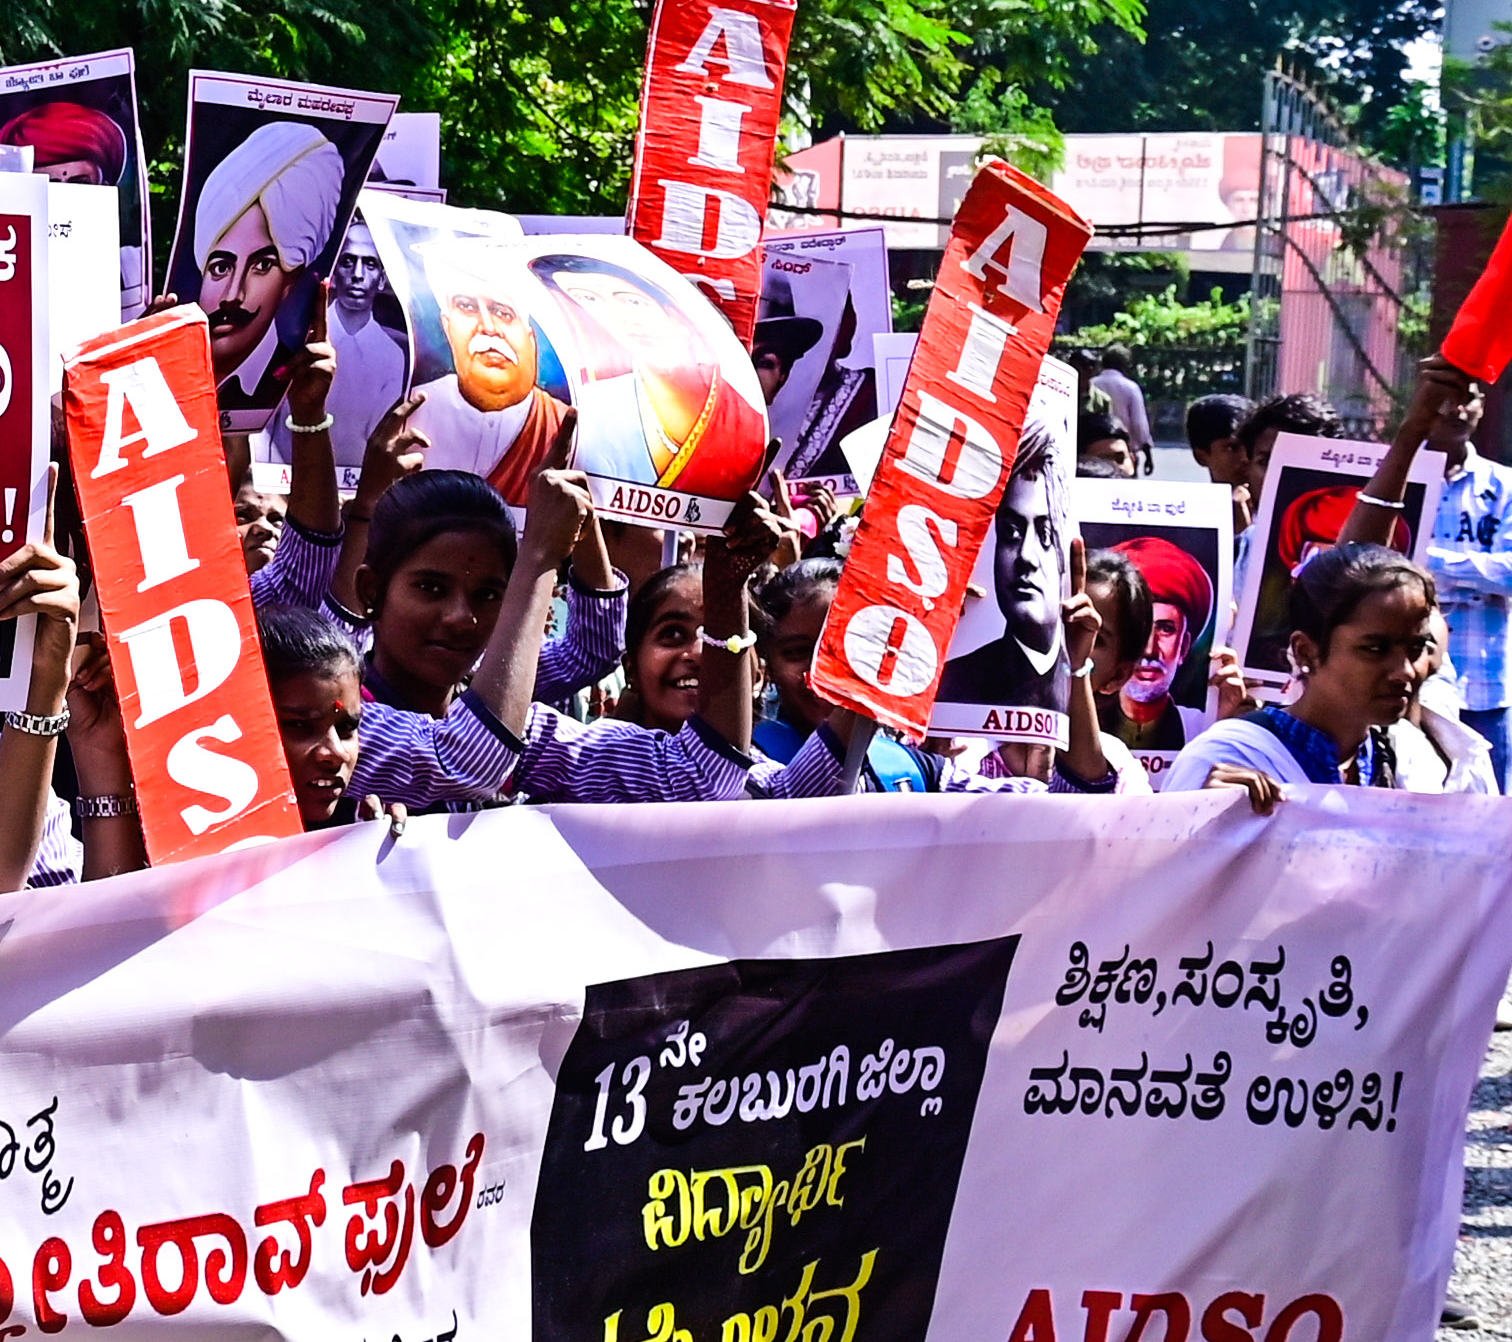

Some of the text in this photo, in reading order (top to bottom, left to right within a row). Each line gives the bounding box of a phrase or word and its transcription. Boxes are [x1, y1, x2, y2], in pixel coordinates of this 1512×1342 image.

[610, 487, 681, 518] AIDSO
[843, 201, 1049, 699] AIDSO
[89, 356, 281, 859] AIDS
[982, 707, 1053, 734] AIDSO
[584, 1055, 652, 1153] 13
[673, 1045, 848, 1130] ಕಲಬುರಗಿ
[1023, 1050, 1403, 1133] ಮಾನವತೆ ಉಳಿಸಿ!
[341, 1132, 484, 1299] ಫುಲೆ
[643, 1138, 867, 1275] ವಿದ್ಯಾರ್ಥಿ
